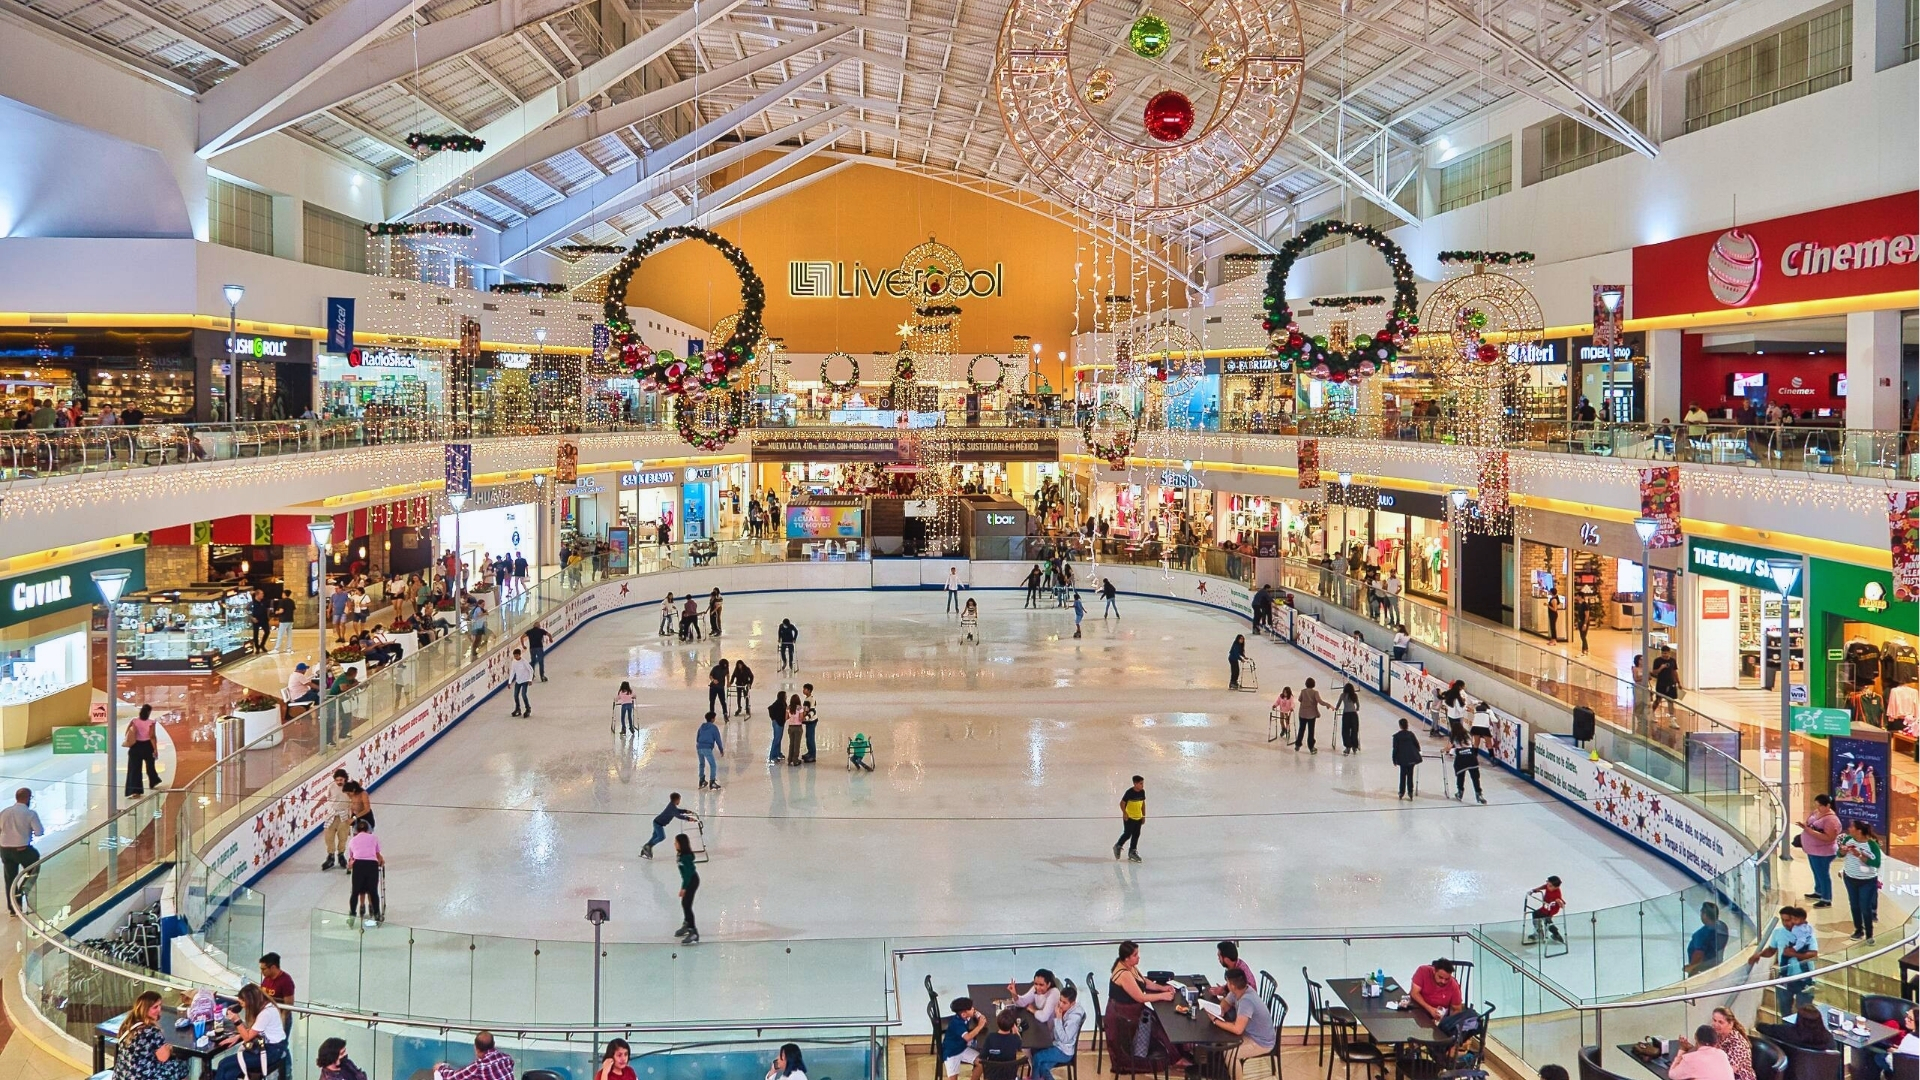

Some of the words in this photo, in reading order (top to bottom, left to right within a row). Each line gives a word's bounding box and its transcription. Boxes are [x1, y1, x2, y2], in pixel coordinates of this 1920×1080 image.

[838, 262, 1002, 302] Liverpool
[225, 338, 253, 354] SUSHI
[263, 338, 284, 356] ROLL
[1614, 347, 1631, 359] shop
[361, 350, 416, 368] RadioShack
[788, 442, 802, 450] LATA
[836, 442, 848, 450] CON
[849, 442, 867, 450] MENOS
[966, 442, 1009, 451] SUSTENTABLE
[1016, 440, 1038, 451] MÉXICO
[1693, 547, 1719, 567] THE
[1719, 551, 1755, 574] BODY
